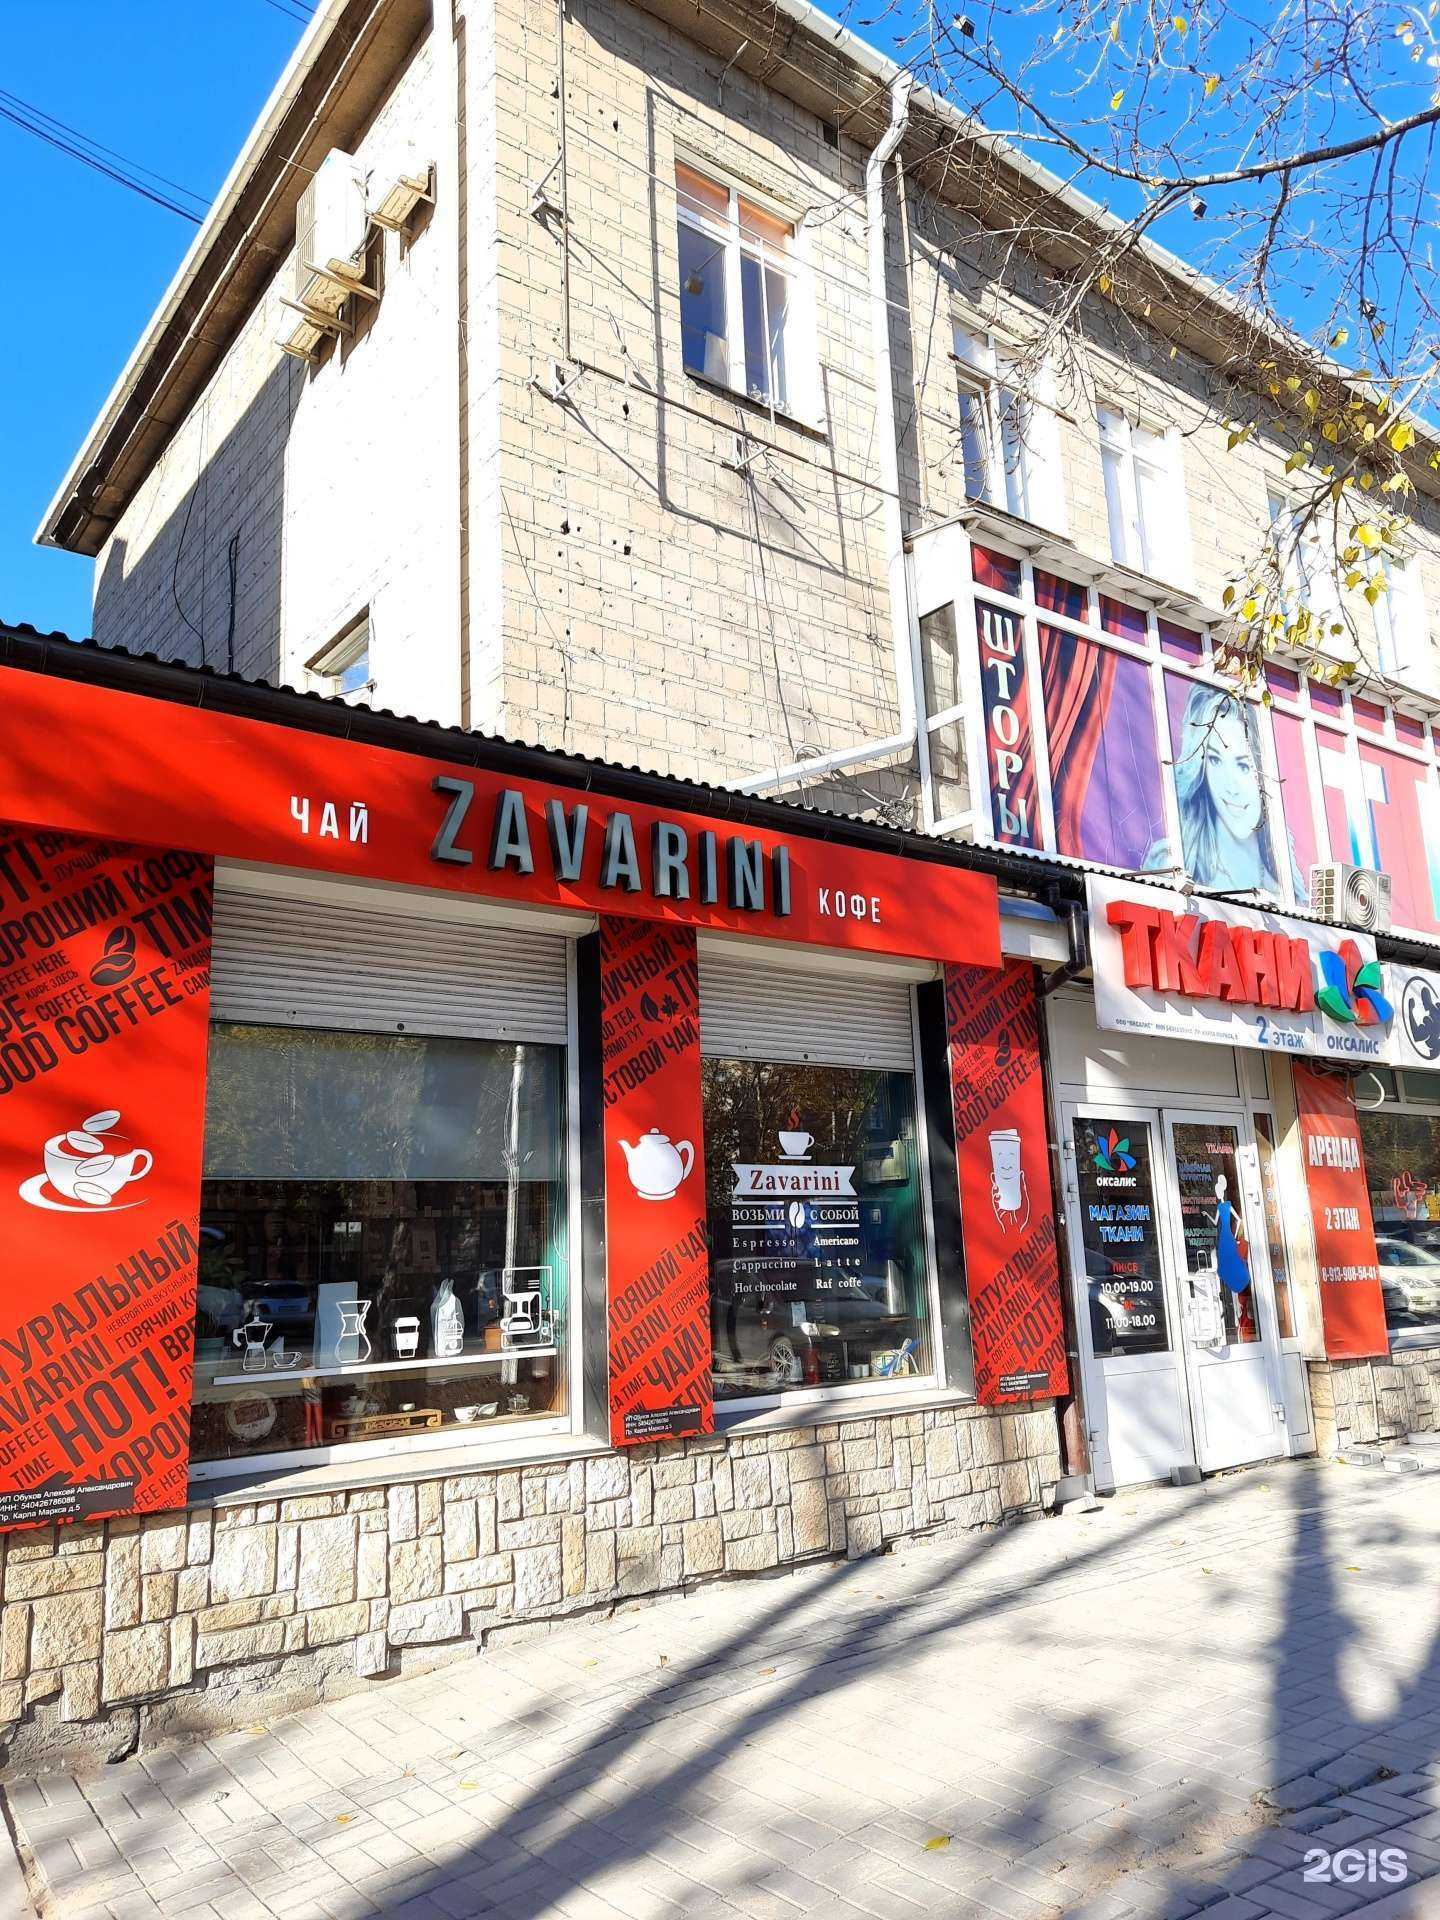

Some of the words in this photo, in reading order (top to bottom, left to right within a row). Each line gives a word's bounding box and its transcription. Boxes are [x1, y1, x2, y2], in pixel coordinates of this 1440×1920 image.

[982, 610, 1030, 839] ШТОРЫ
[290, 796, 368, 843] ЧАЙ
[430, 775, 792, 917] ZAVARINI
[818, 886, 882, 924] КОФЕ
[32, 950, 71, 977] HERE
[1106, 900, 1315, 1013] ТКАНИ
[35, 984, 92, 1021] COFFEE
[54, 966, 184, 1055] COFFEE
[612, 1006, 637, 1030] TEA
[1256, 1016, 1269, 1044] 2
[1273, 1031, 1305, 1048] этаж
[662, 1014, 699, 1055] ЧАЙ
[985, 1054, 1033, 1110] COFFEE
[1308, 1135, 1361, 1172] АРЕНДА
[750, 1170, 840, 1191] Zavarini
[732, 1209, 785, 1221] ВОЗЬМИ
[810, 1210, 818, 1220] С
[820, 1207, 859, 1220] СОБОЙ
[1089, 1204, 1151, 1221] МАГАЗИН
[1325, 1207, 1333, 1230] 2
[1334, 1207, 1361, 1230] ЭТАЖ
[732, 1238, 795, 1251] Espresso
[813, 1235, 859, 1246] Americano
[1099, 1226, 1144, 1242] ТКАНИ
[733, 1259, 796, 1273] Cappuccino
[814, 1258, 861, 1268] Latte
[735, 1282, 752, 1293] Hot
[755, 1281, 797, 1292] chocolate
[816, 1278, 833, 1289] Raf
[838, 1277, 862, 1288] coffe
[1101, 1280, 1153, 1294] 10.00-19.00
[0, 1219, 199, 1386] УРАЛЬНЫЙ
[115, 1300, 182, 1354] ГОРЯЧИЙ
[979, 1283, 1032, 1353] ZAVARINI
[1010, 1294, 1059, 1364] HOT!
[1105, 1314, 1156, 1329] 11.00-18.00
[643, 1322, 710, 1393] ЧАЙ!
[620, 1372, 647, 1400] TIME
[45, 1346, 177, 1468] HOT!
[9, 1451, 54, 1488] TIME
[13, 1492, 42, 1504] Обухов
[43, 1487, 75, 1498] Алексей
[76, 1481, 134, 1494] Александрович
[13, 1510, 37, 1520] Карла
[38, 1506, 67, 1517] Маркса
